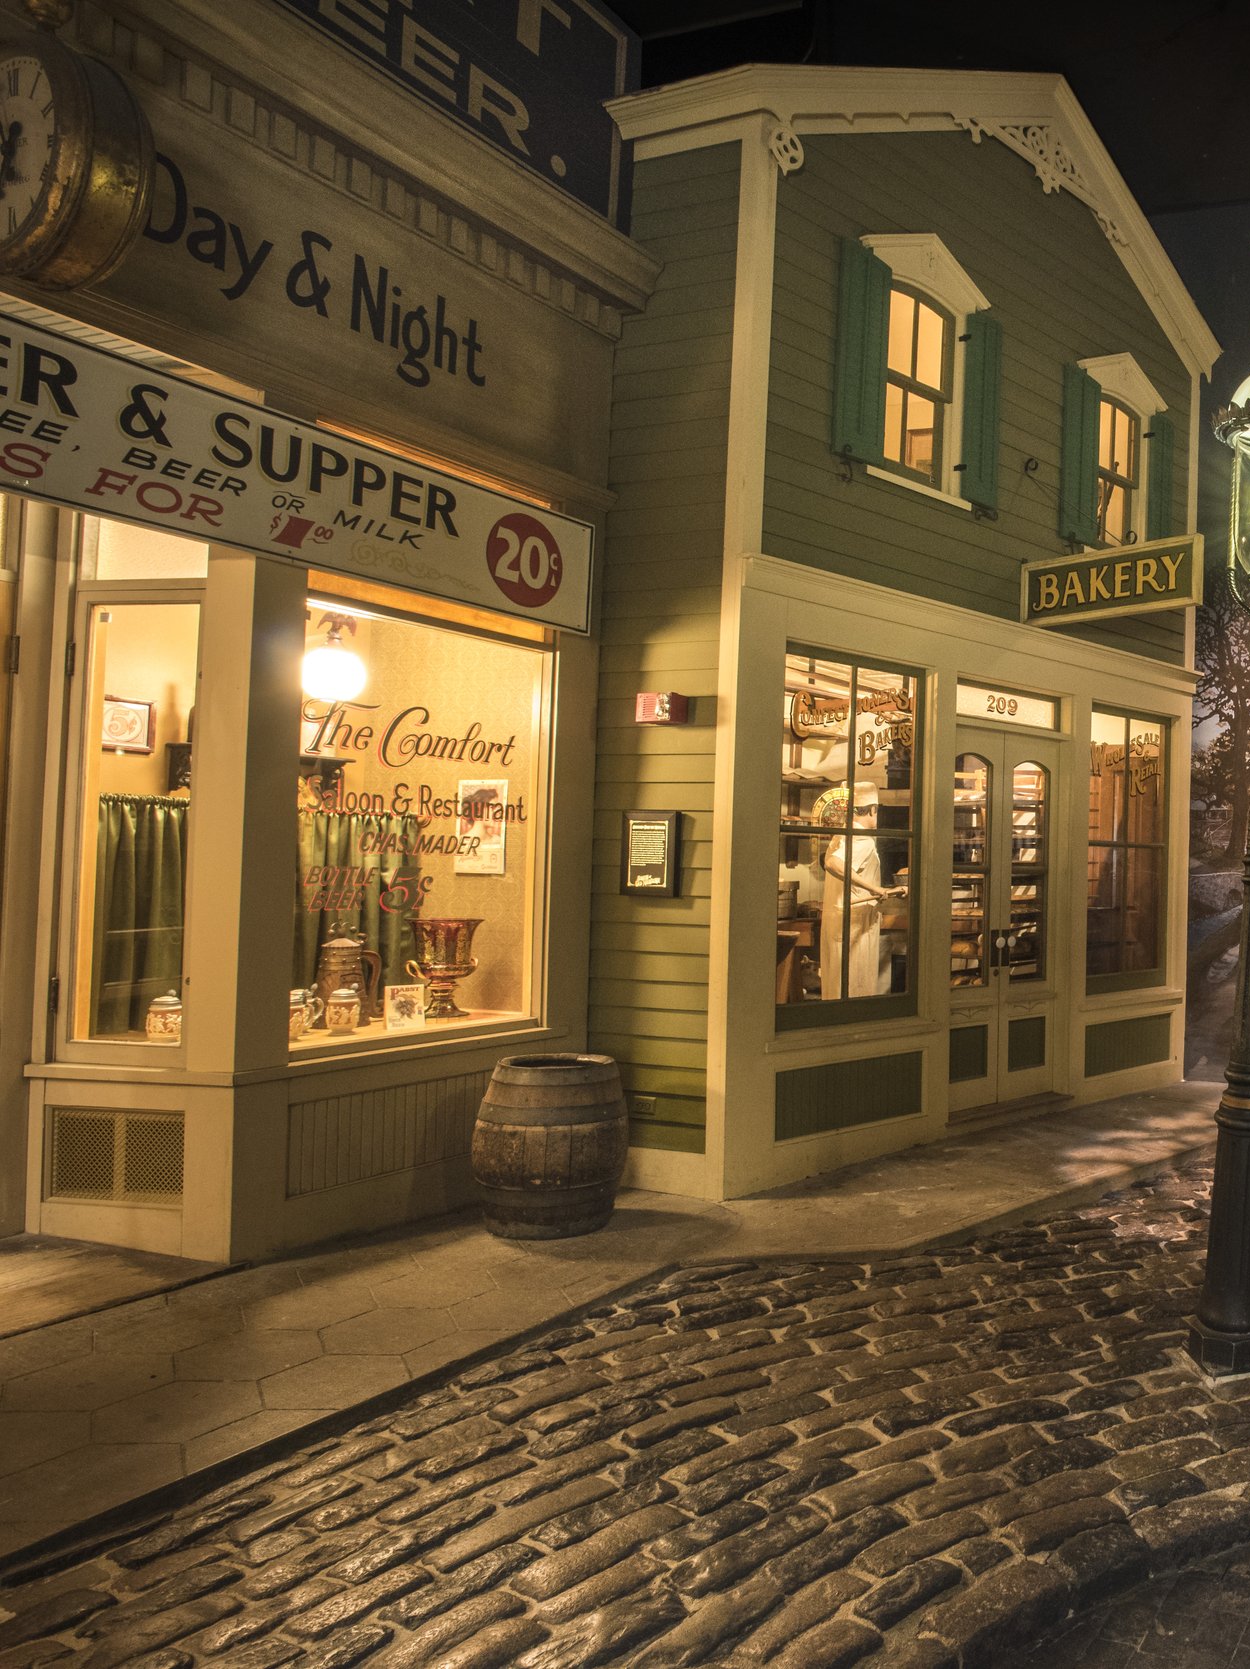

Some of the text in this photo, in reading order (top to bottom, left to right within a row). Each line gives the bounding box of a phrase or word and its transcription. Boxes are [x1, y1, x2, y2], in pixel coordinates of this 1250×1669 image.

[142, 153, 486, 388] Day & Night
[119, 383, 173, 448] &
[211, 411, 460, 538] SUPPER
[84, 467, 225, 527] FOR
[121, 446, 248, 497] BEER
[271, 494, 305, 514] OR
[333, 510, 425, 549] MILK
[1032, 552, 1186, 612] BAKERY
[302, 698, 516, 768] The Comfort
[987, 694, 1018, 716] 209
[304, 774, 528, 824] Saloon & Restaurant
[412, 832, 481, 856] MADER
[304, 865, 380, 888] BOTTLE
[307, 889, 368, 912] BEER
